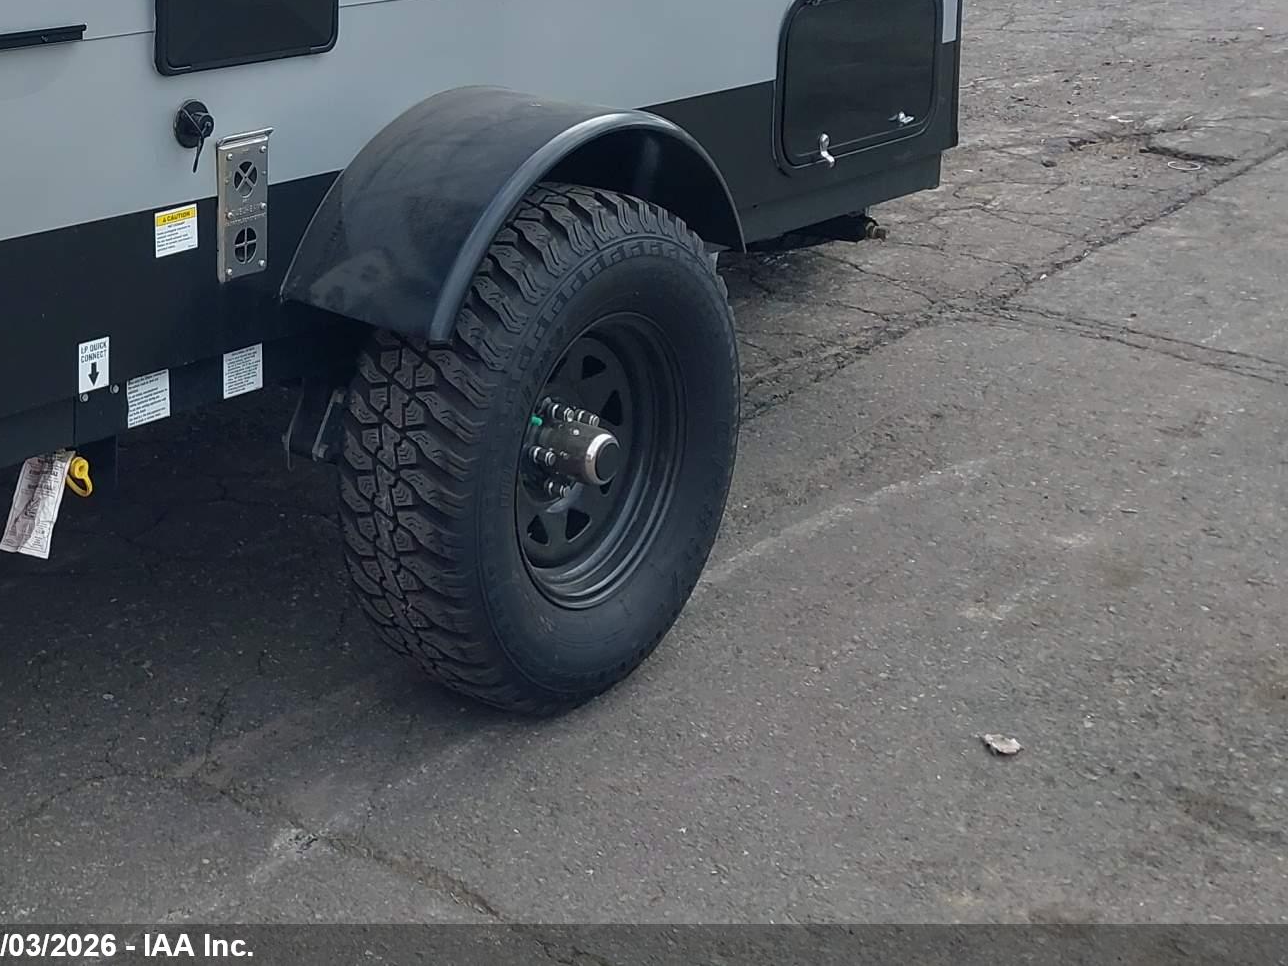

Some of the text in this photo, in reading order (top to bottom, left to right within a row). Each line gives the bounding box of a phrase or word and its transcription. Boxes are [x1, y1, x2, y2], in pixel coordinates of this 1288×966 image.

[166, 210, 192, 221] CAUTION
[89, 341, 107, 353] QUICK
[80, 348, 107, 364] CONNECT
